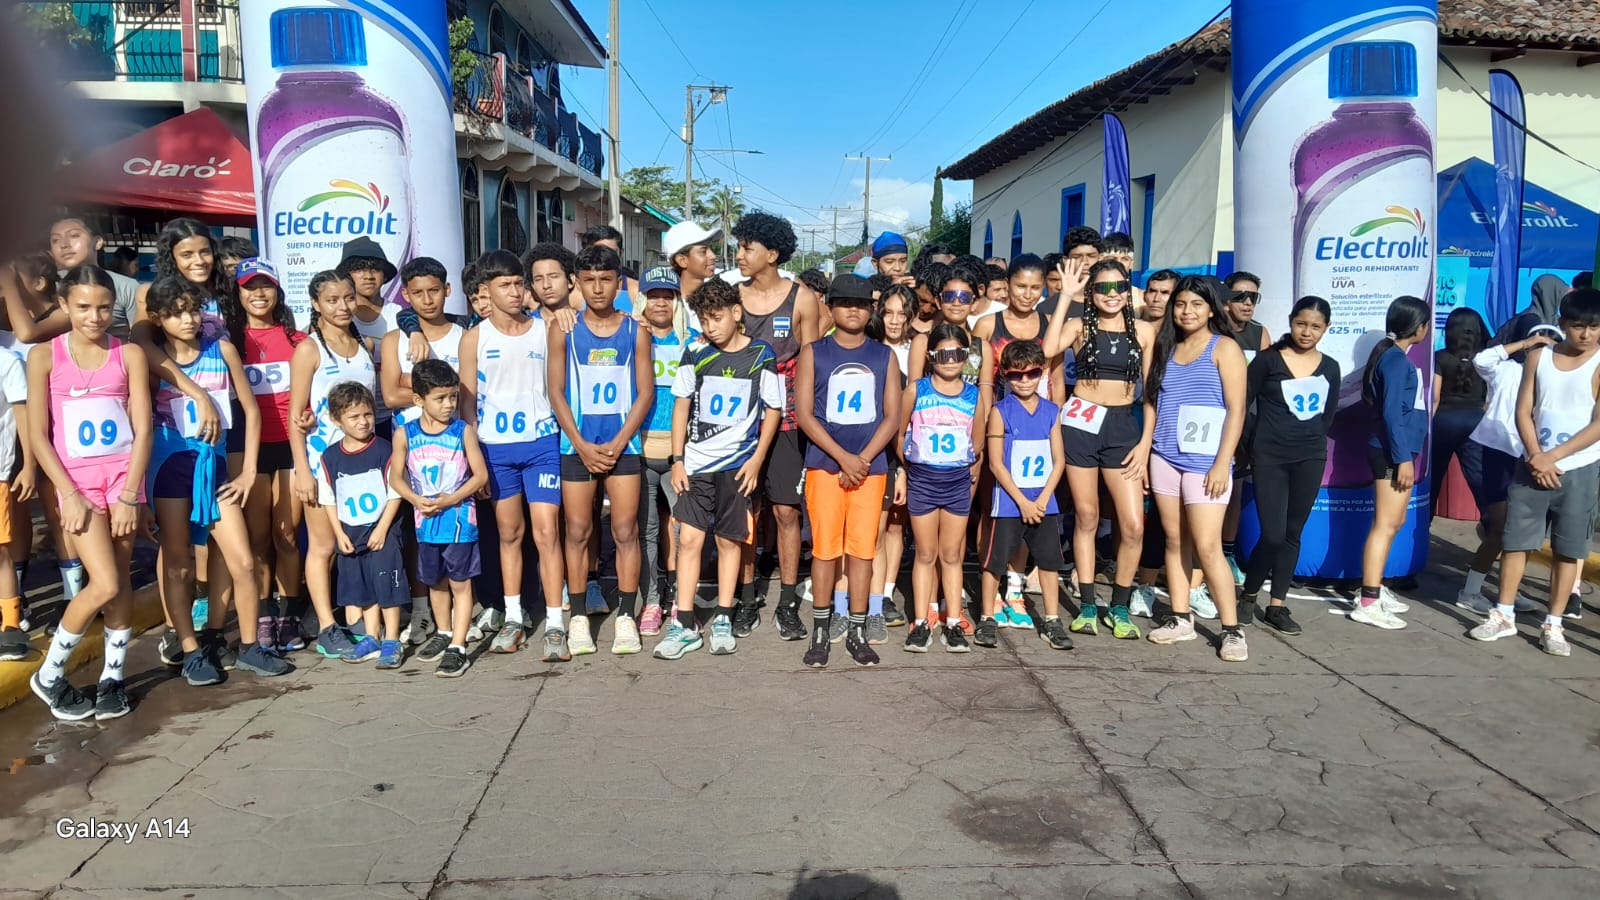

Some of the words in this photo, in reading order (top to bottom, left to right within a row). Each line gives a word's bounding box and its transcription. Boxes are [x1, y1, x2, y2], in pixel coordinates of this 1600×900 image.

[123, 157, 216, 178] Claro
[275, 211, 397, 236] Electrolit
[1315, 236, 1428, 260] Electrolit
[287, 257, 305, 265] UVA
[1331, 280, 1355, 288] UVA
[1353, 326, 1368, 334] mL
[245, 365, 282, 387] 05
[653, 360, 679, 378] 03
[593, 382, 617, 405] 10
[710, 393, 742, 417] 07
[837, 390, 862, 413] 14
[1293, 393, 1320, 413] 32
[495, 411, 526, 434] 06
[1066, 399, 1098, 423] 24
[78, 419, 118, 447] 09
[929, 433, 956, 454] 13
[1183, 421, 1211, 443] 21
[1022, 455, 1045, 478] 12
[344, 492, 379, 518] 10
